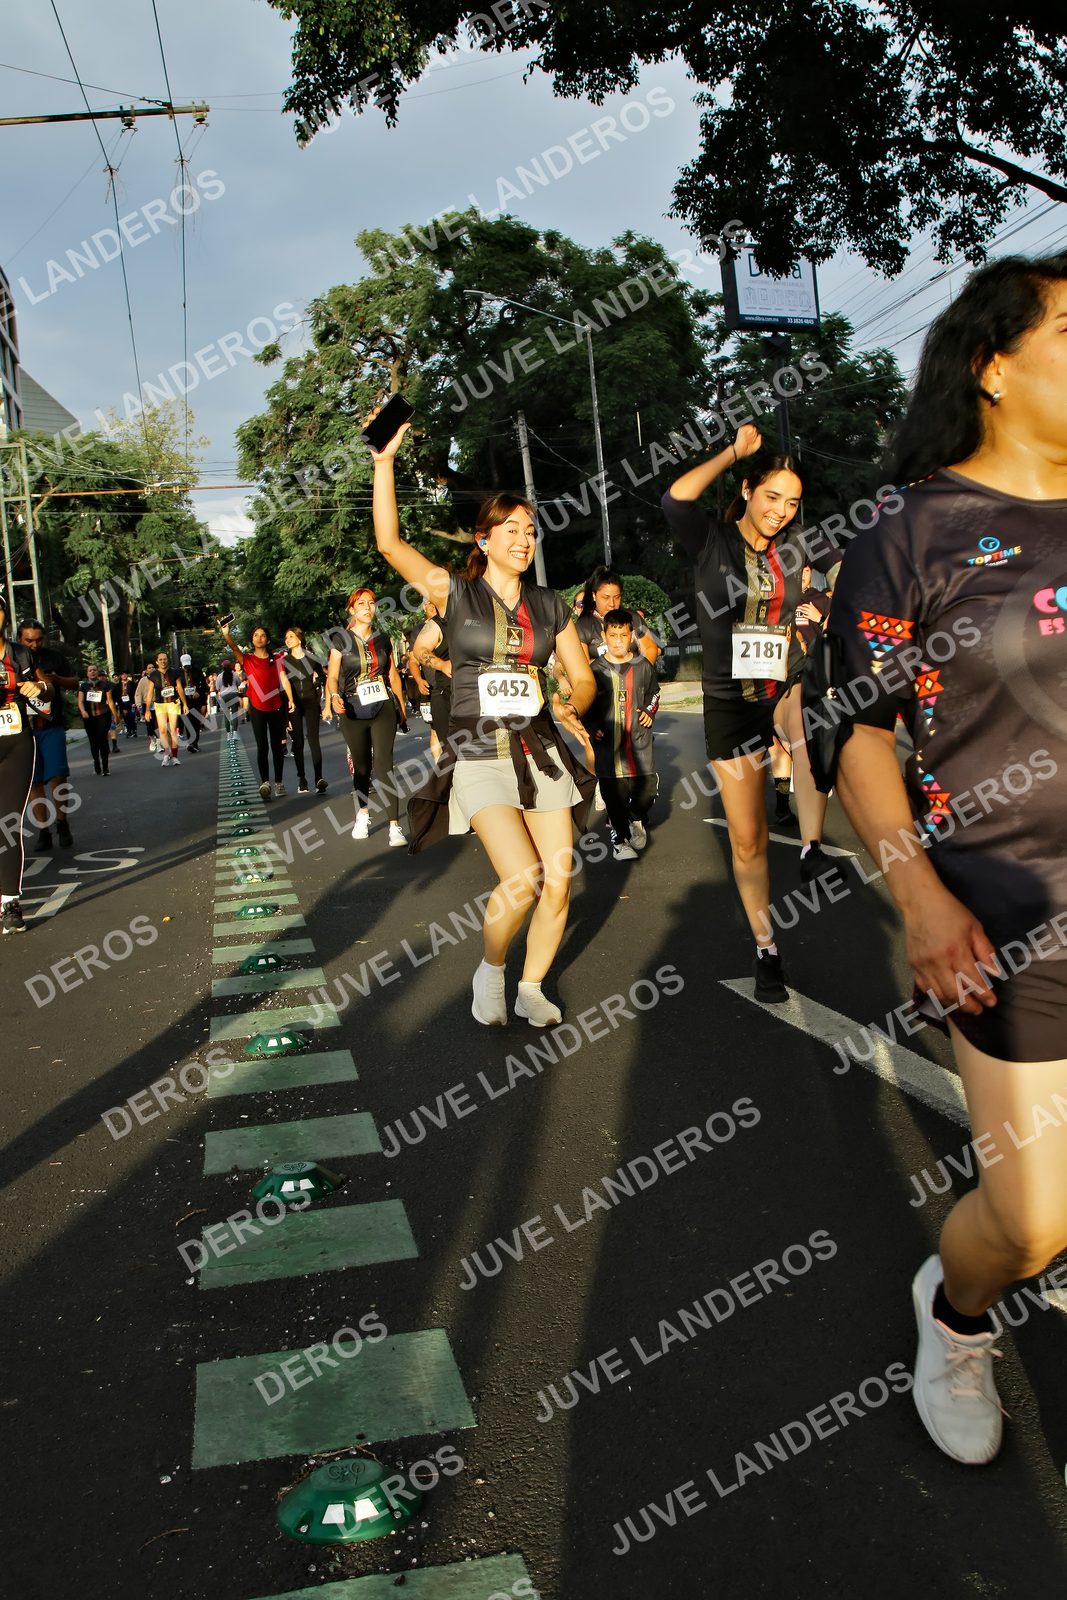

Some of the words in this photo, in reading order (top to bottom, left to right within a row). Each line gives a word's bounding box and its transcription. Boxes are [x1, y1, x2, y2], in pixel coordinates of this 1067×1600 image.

[967, 546, 1022, 566] TOPTIME
[740, 641, 782, 660] 2181
[362, 684, 381, 696] 2718
[487, 679, 530, 697] 6452
